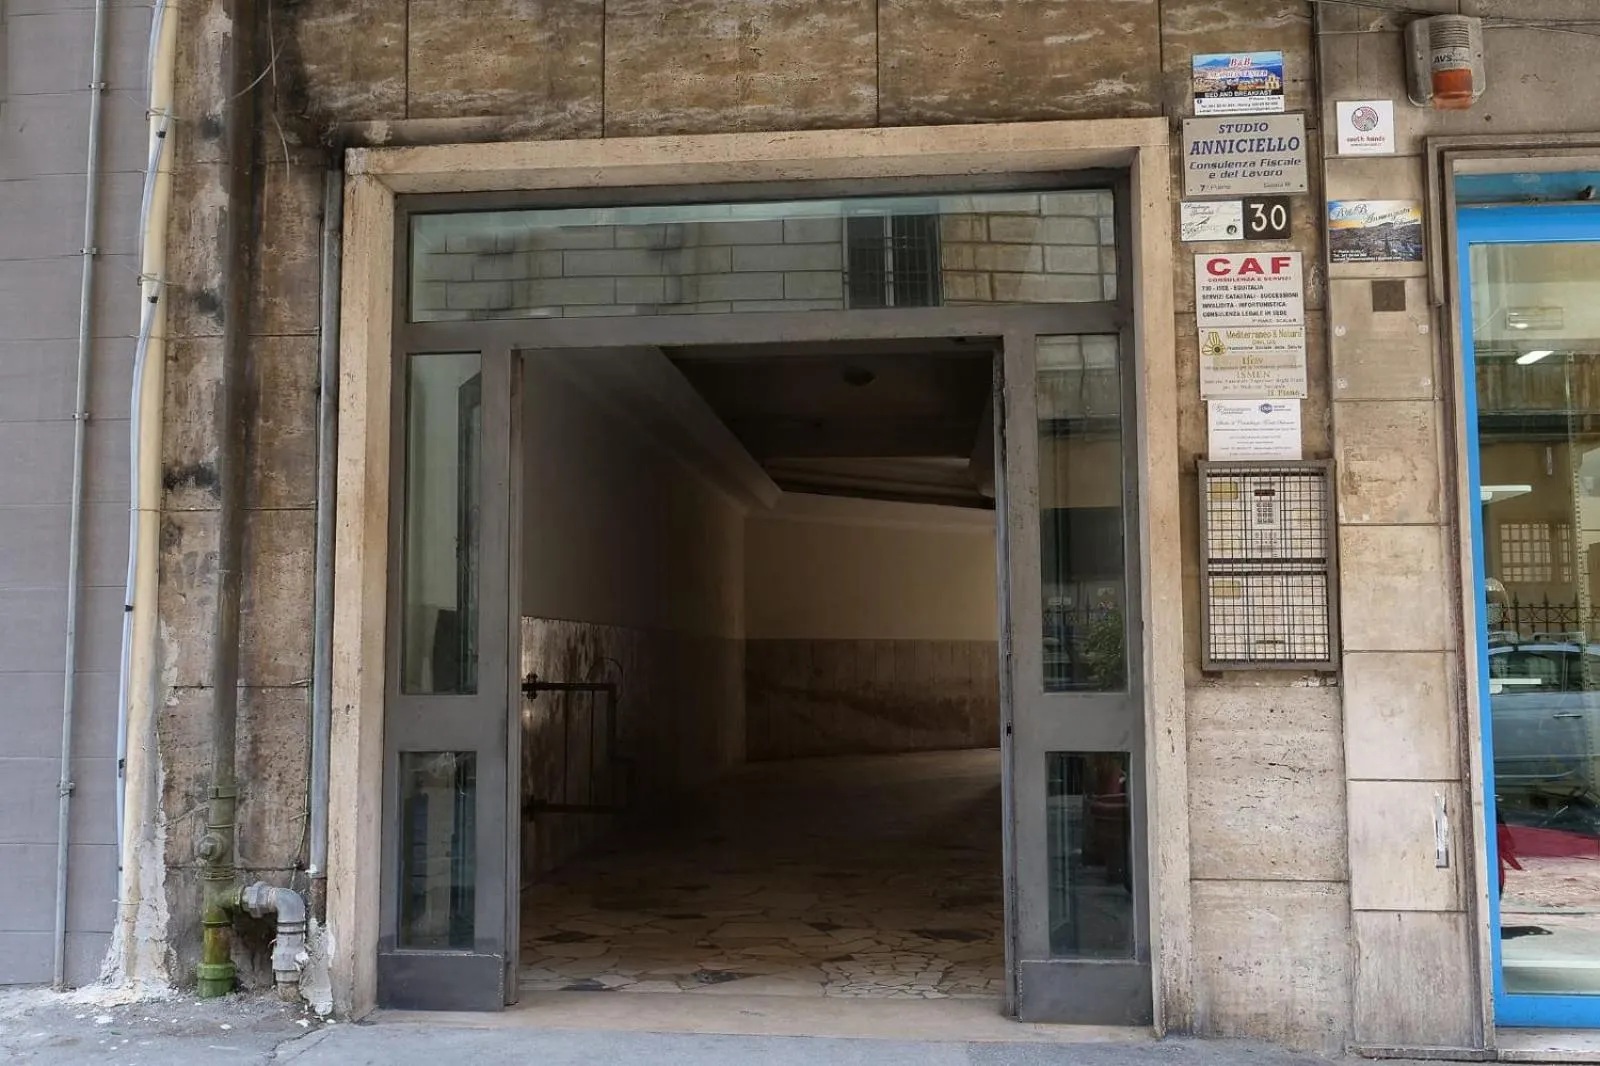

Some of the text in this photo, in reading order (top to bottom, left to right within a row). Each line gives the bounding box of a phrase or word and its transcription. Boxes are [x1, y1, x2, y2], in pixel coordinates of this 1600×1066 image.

[1434, 55, 1453, 63] AVS
[1235, 89, 1272, 98] BREAKFAST
[1218, 122, 1270, 135] STUDIO
[1189, 136, 1301, 156] ANNICIELLO
[1189, 157, 1302, 171] Consulenza Fiscale
[1219, 170, 1239, 179] del
[1241, 169, 1284, 178] Lavoro
[1250, 203, 1287, 232] 30
[1206, 257, 1291, 276] CAF
[1226, 330, 1272, 339] Mediterraneo
